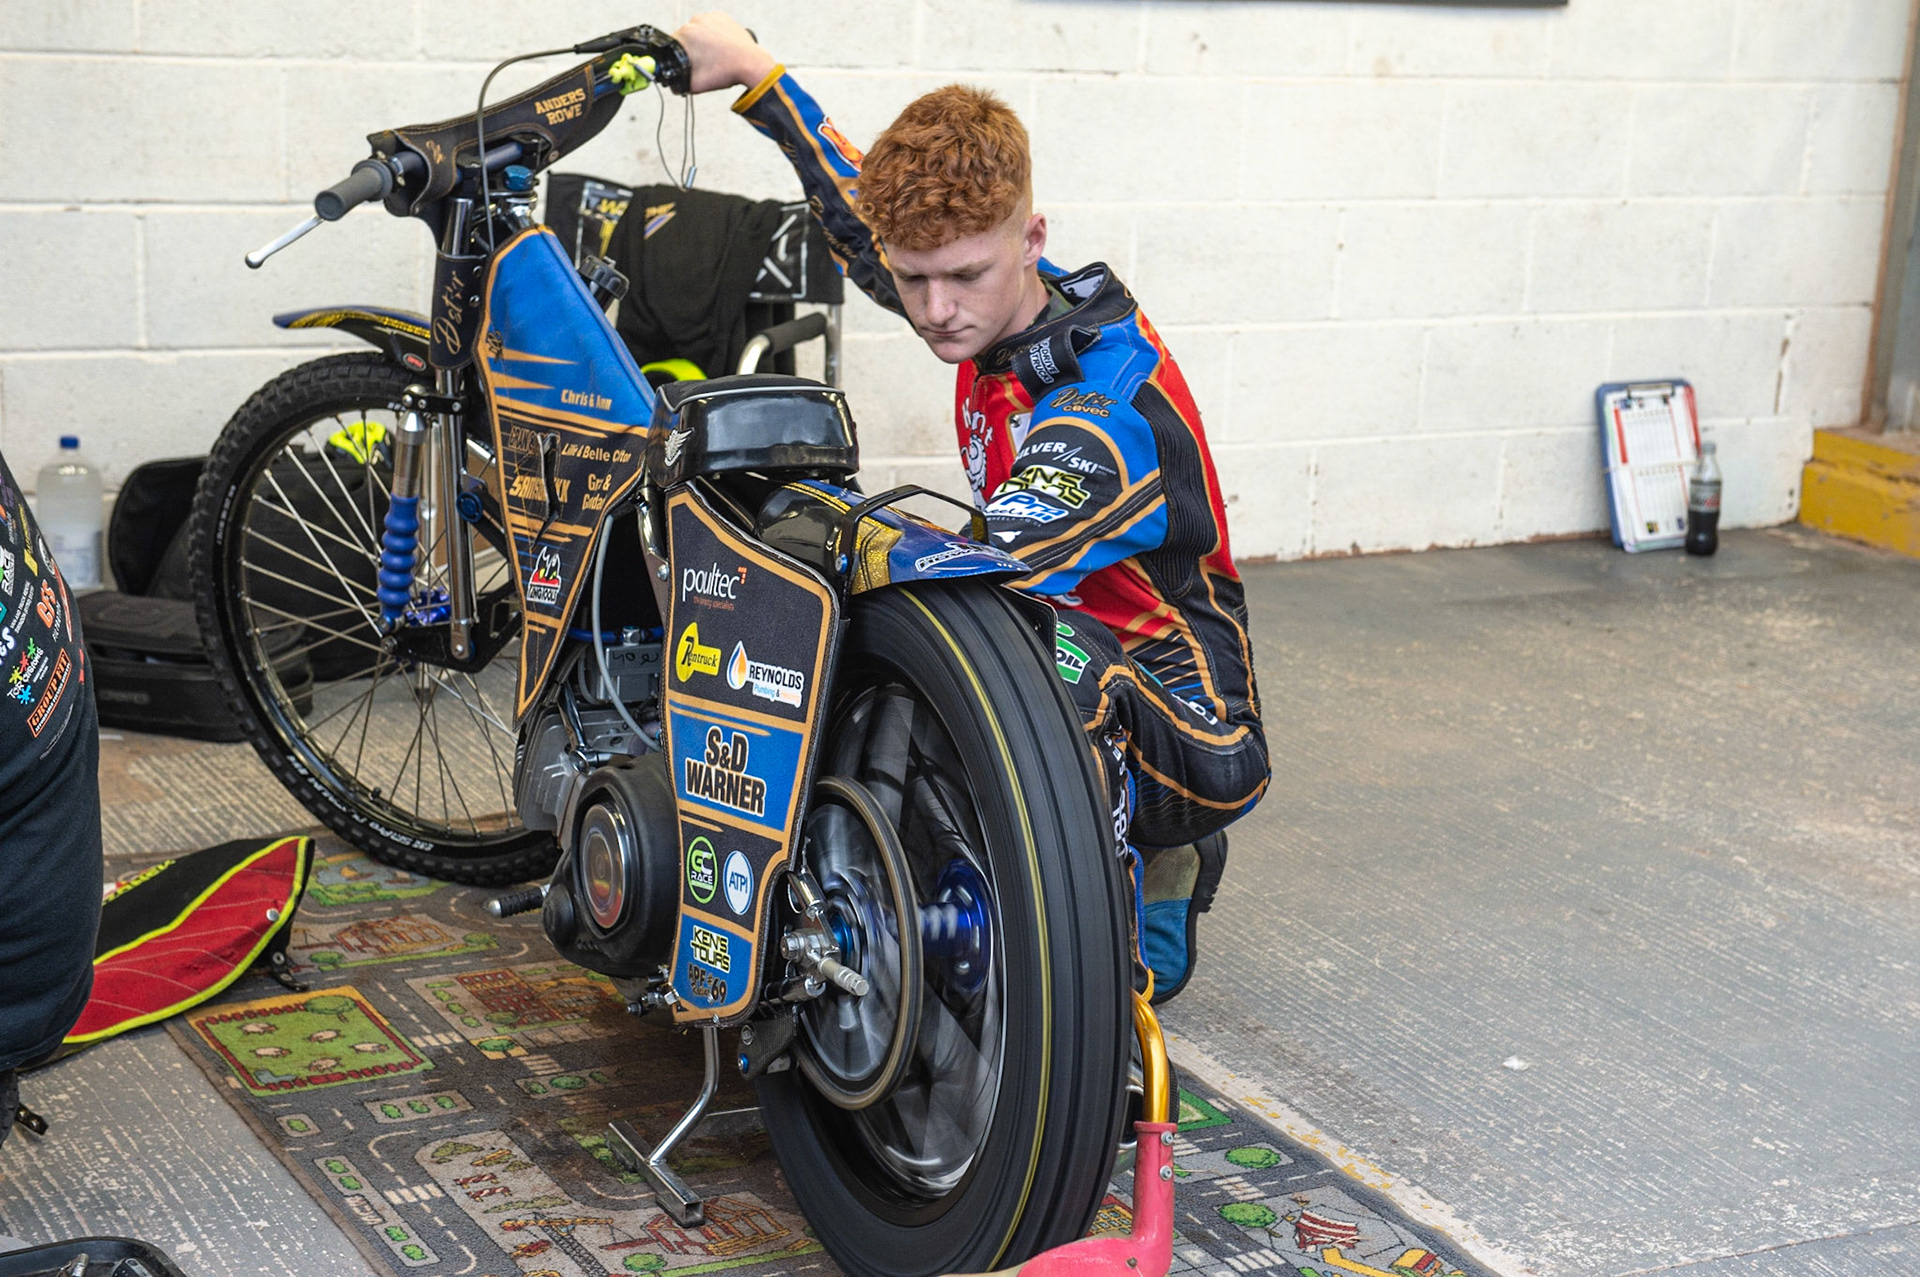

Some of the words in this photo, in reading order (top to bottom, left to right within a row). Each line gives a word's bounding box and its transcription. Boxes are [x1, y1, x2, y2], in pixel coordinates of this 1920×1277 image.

[535, 87, 586, 115] ANDERS
[546, 103, 582, 125] ROWE
[1031, 353, 1053, 383] TRUCKS
[1041, 348, 1059, 374] DRIVE
[561, 389, 588, 406] Chris
[582, 446, 610, 462] Belle
[1068, 457, 1098, 474] SKI
[602, 474, 612, 491] &
[682, 562, 740, 602] poultec
[681, 636, 718, 668] Rentruck
[31, 678, 58, 726] GROUP
[55, 654, 69, 682] FIT
[749, 665, 803, 691] REYNOLDS
[776, 687, 781, 698] &
[706, 726, 749, 773] S&D
[686, 758, 767, 816] WARNER
[691, 871, 713, 885] RACE
[729, 871, 748, 894] ATPI
[693, 926, 729, 954] KEN'S
[691, 941, 730, 972] TOURS
